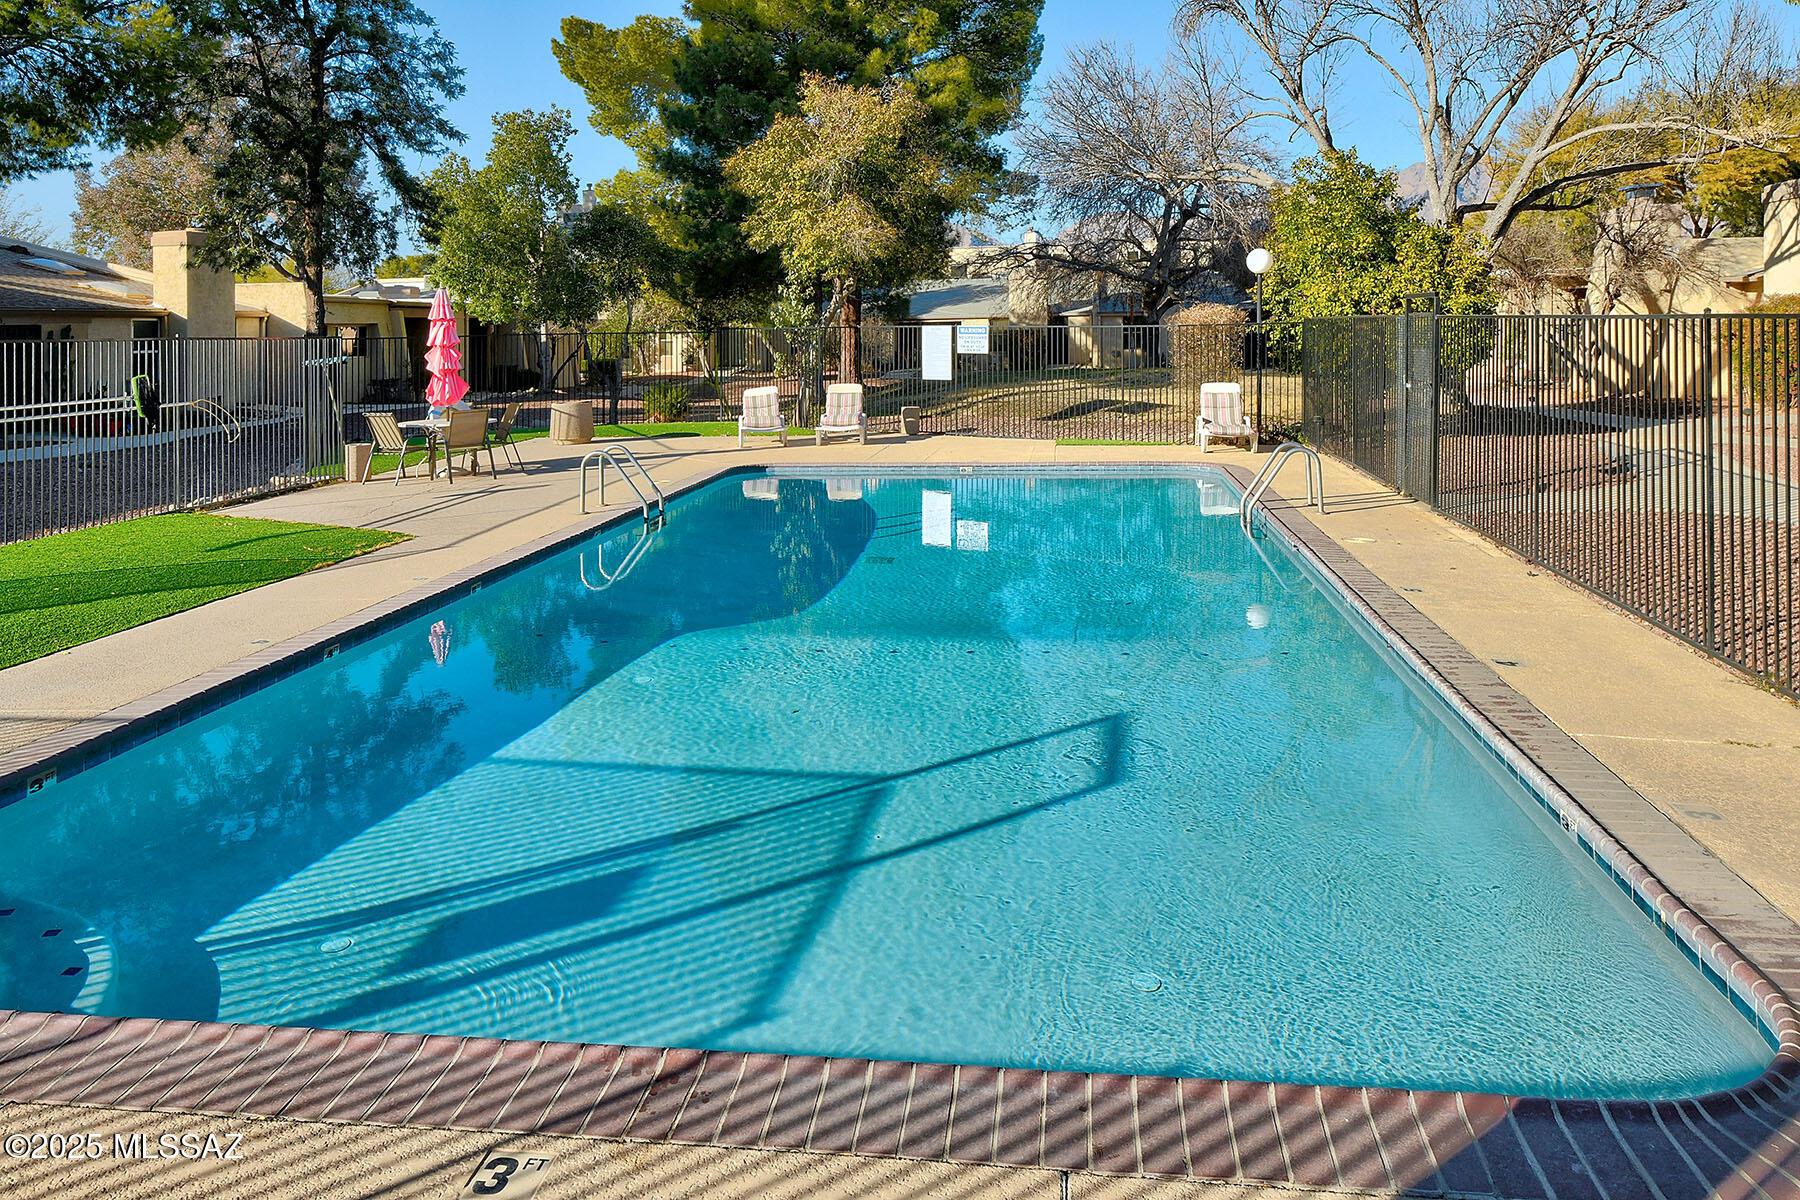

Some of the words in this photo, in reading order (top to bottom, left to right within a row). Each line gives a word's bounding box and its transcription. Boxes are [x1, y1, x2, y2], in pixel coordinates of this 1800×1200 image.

[28, 777, 44, 794] 3
[44, 769, 56, 782] FT
[472, 1157, 519, 1195] 3
[522, 1158, 549, 1171] FT
